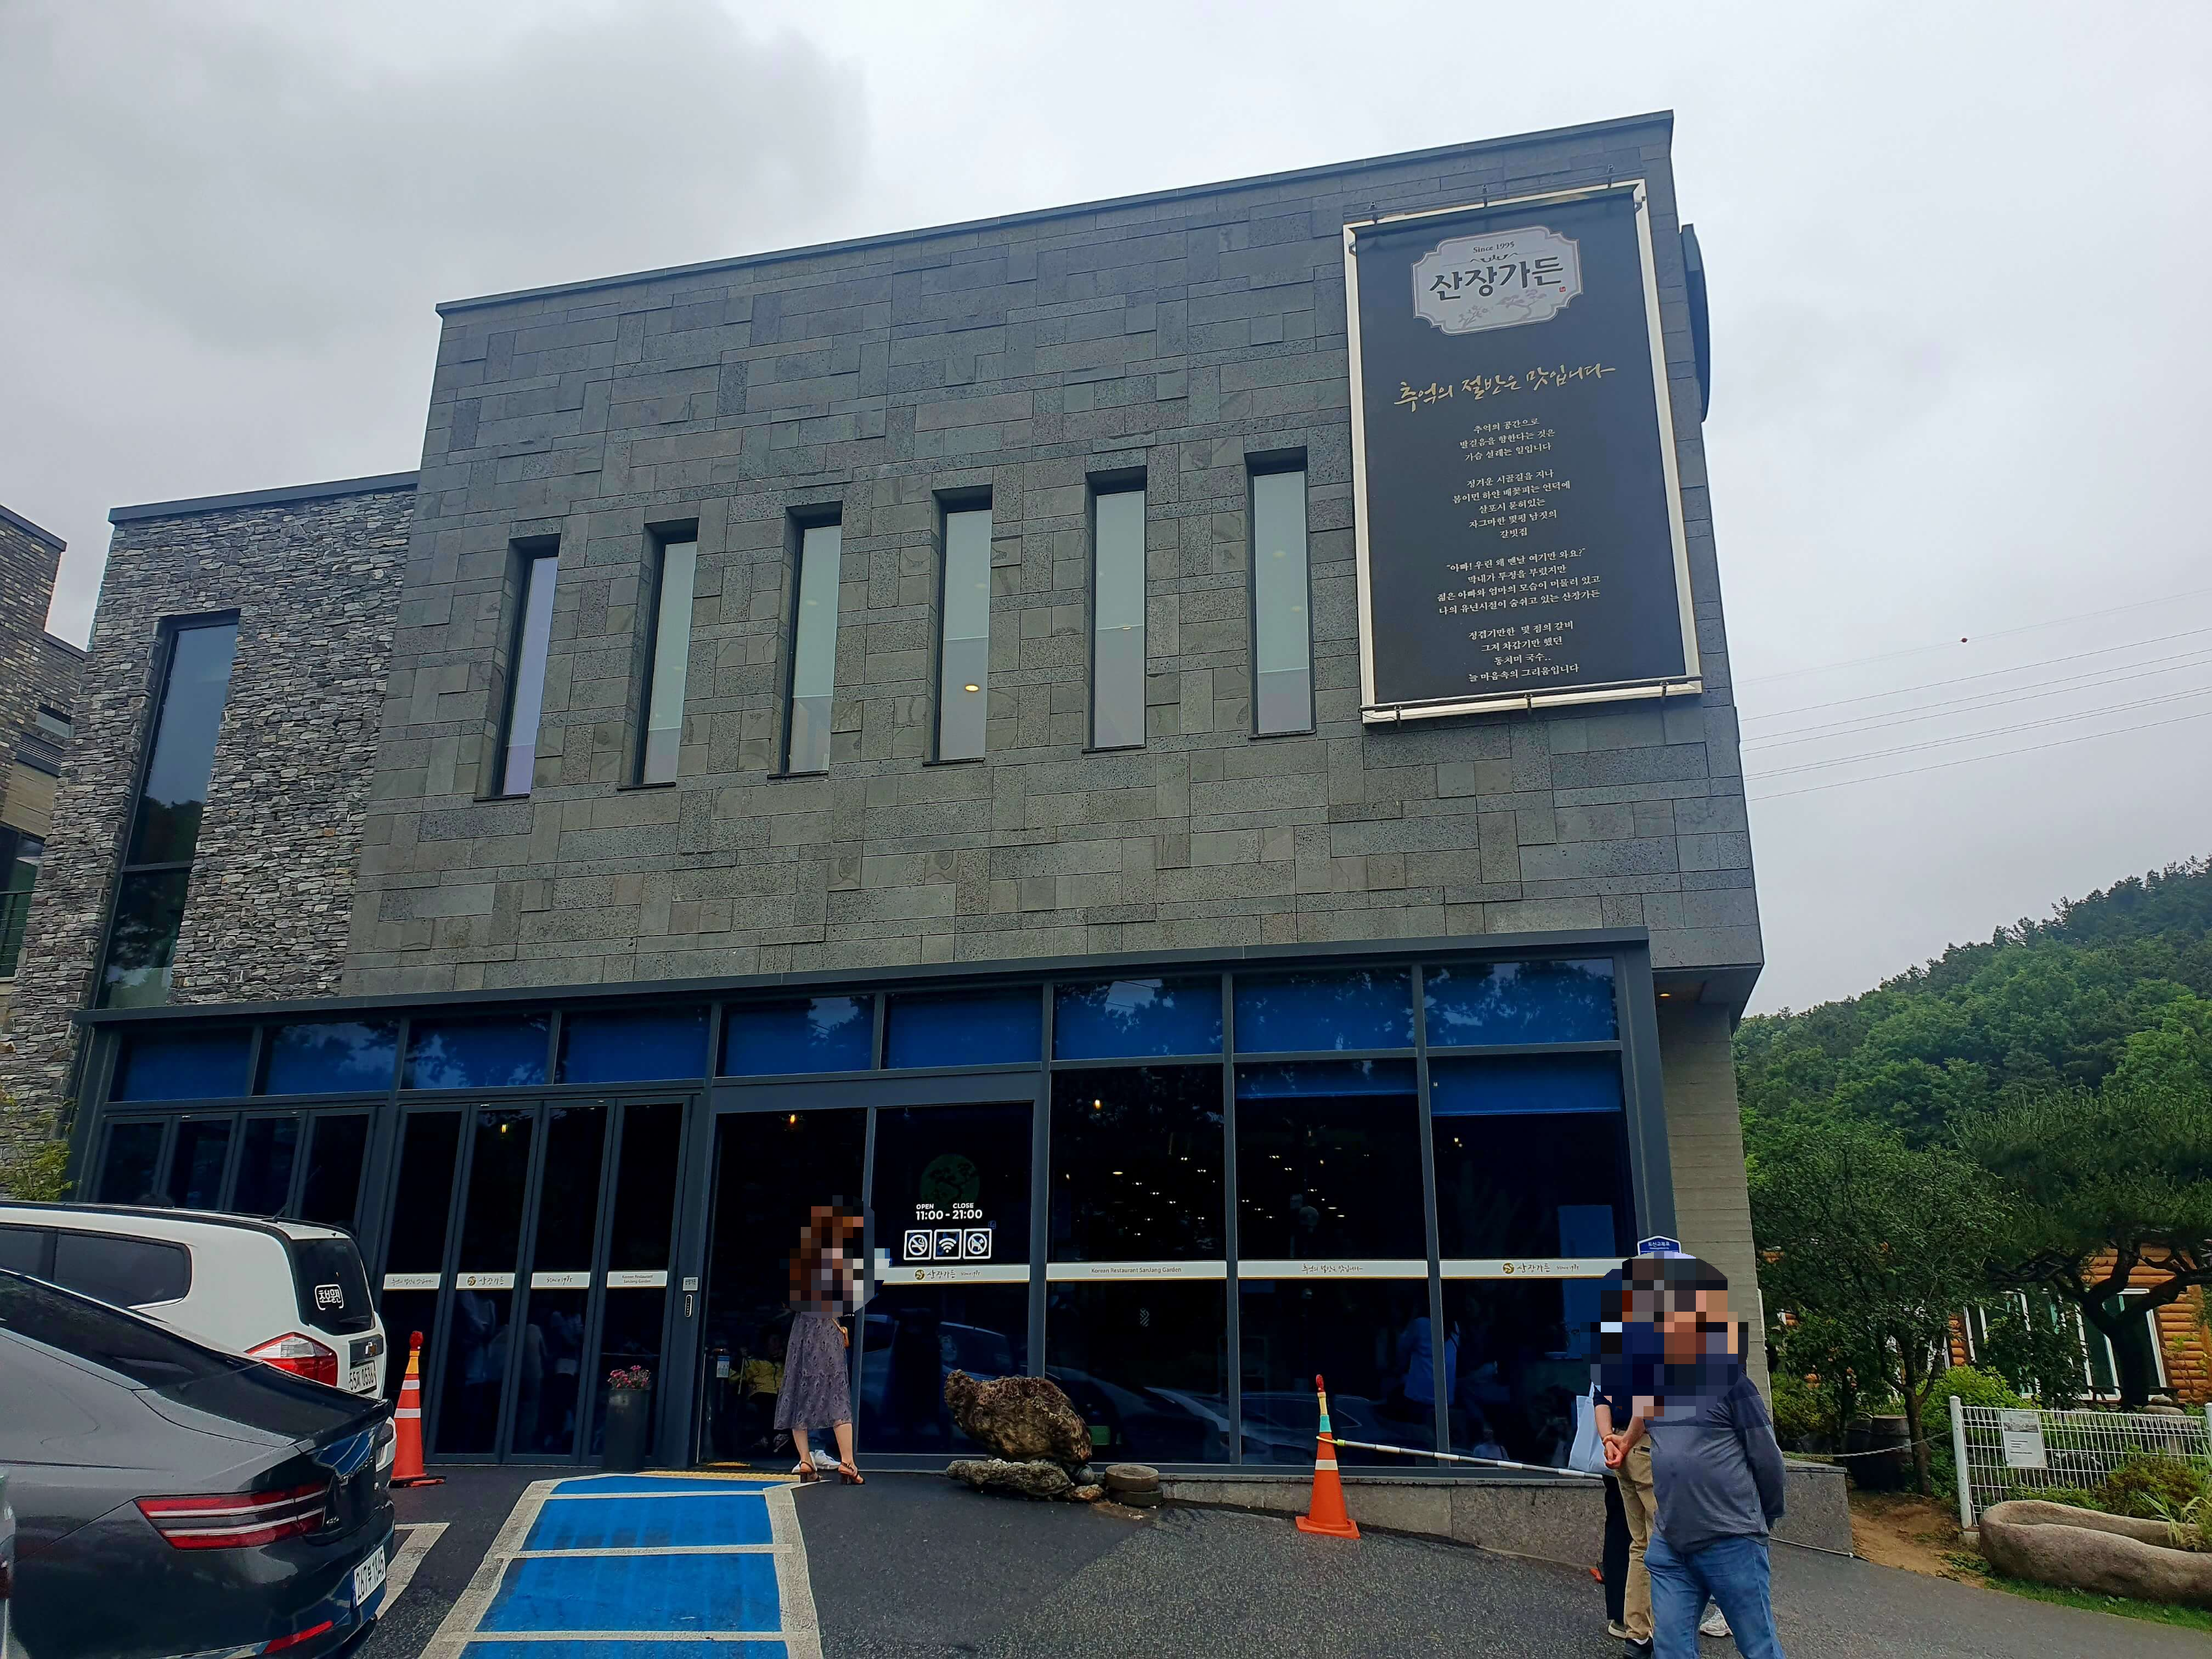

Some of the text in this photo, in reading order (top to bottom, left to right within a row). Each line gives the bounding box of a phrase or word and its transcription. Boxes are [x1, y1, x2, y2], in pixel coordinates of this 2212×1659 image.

[1472, 246, 1494, 254] Since
[1429, 255, 1564, 302] 산장가든
[1394, 363, 1615, 412] 추억의 절반은 맛입니다
[1473, 417, 1540, 434] 추억의 공간으로
[1460, 429, 1555, 449] 발걸음을 향한다는 것은
[1465, 442, 1552, 462] 가슴 설레는 일입니다
[1497, 472, 1534, 484] 시골길을
[1536, 469, 1554, 479] 지나
[1453, 480, 1571, 504] 봄이면 하얀 배꽃피는 언덕에
[1478, 502, 1506, 514] 살포시
[1469, 517, 1506, 529] 자그마한
[1530, 509, 1557, 521] 남짓의
[1500, 527, 1528, 539] 갈빗집
[1475, 559, 1493, 569] 우린
[1495, 558, 1504, 567] 왜
[1528, 552, 1557, 563] 여기만
[1467, 564, 1567, 584] 막내가 투정을 부렸지만
[1437, 592, 1455, 602] 젊은
[1458, 588, 1486, 599] 아빠와
[1489, 584, 1516, 596] 엄마의
[1519, 580, 1547, 592] 모습이
[1582, 575, 1601, 585] 있고
[1439, 589, 1601, 615] 나의 유년시절이 숨쉬고 있는 산장가든
[1468, 620, 1573, 640] 정겹기만한 몇 점의 갈비
[1481, 636, 1563, 652] 그저 차갑기만 했던
[1494, 653, 1551, 666] 동치미 국수..
[1468, 663, 1579, 682] 늘 마음속의 그리움입니다
[916, 1210, 944, 1220] 11:00
[952, 1209, 983, 1220] 21:00
[927, 1269, 956, 1279] 산장가든
[1517, 1262, 1550, 1273] 산장가든
[479, 1276, 504, 1285] 산장가든
[318, 1289, 341, 1304] 초보운전
